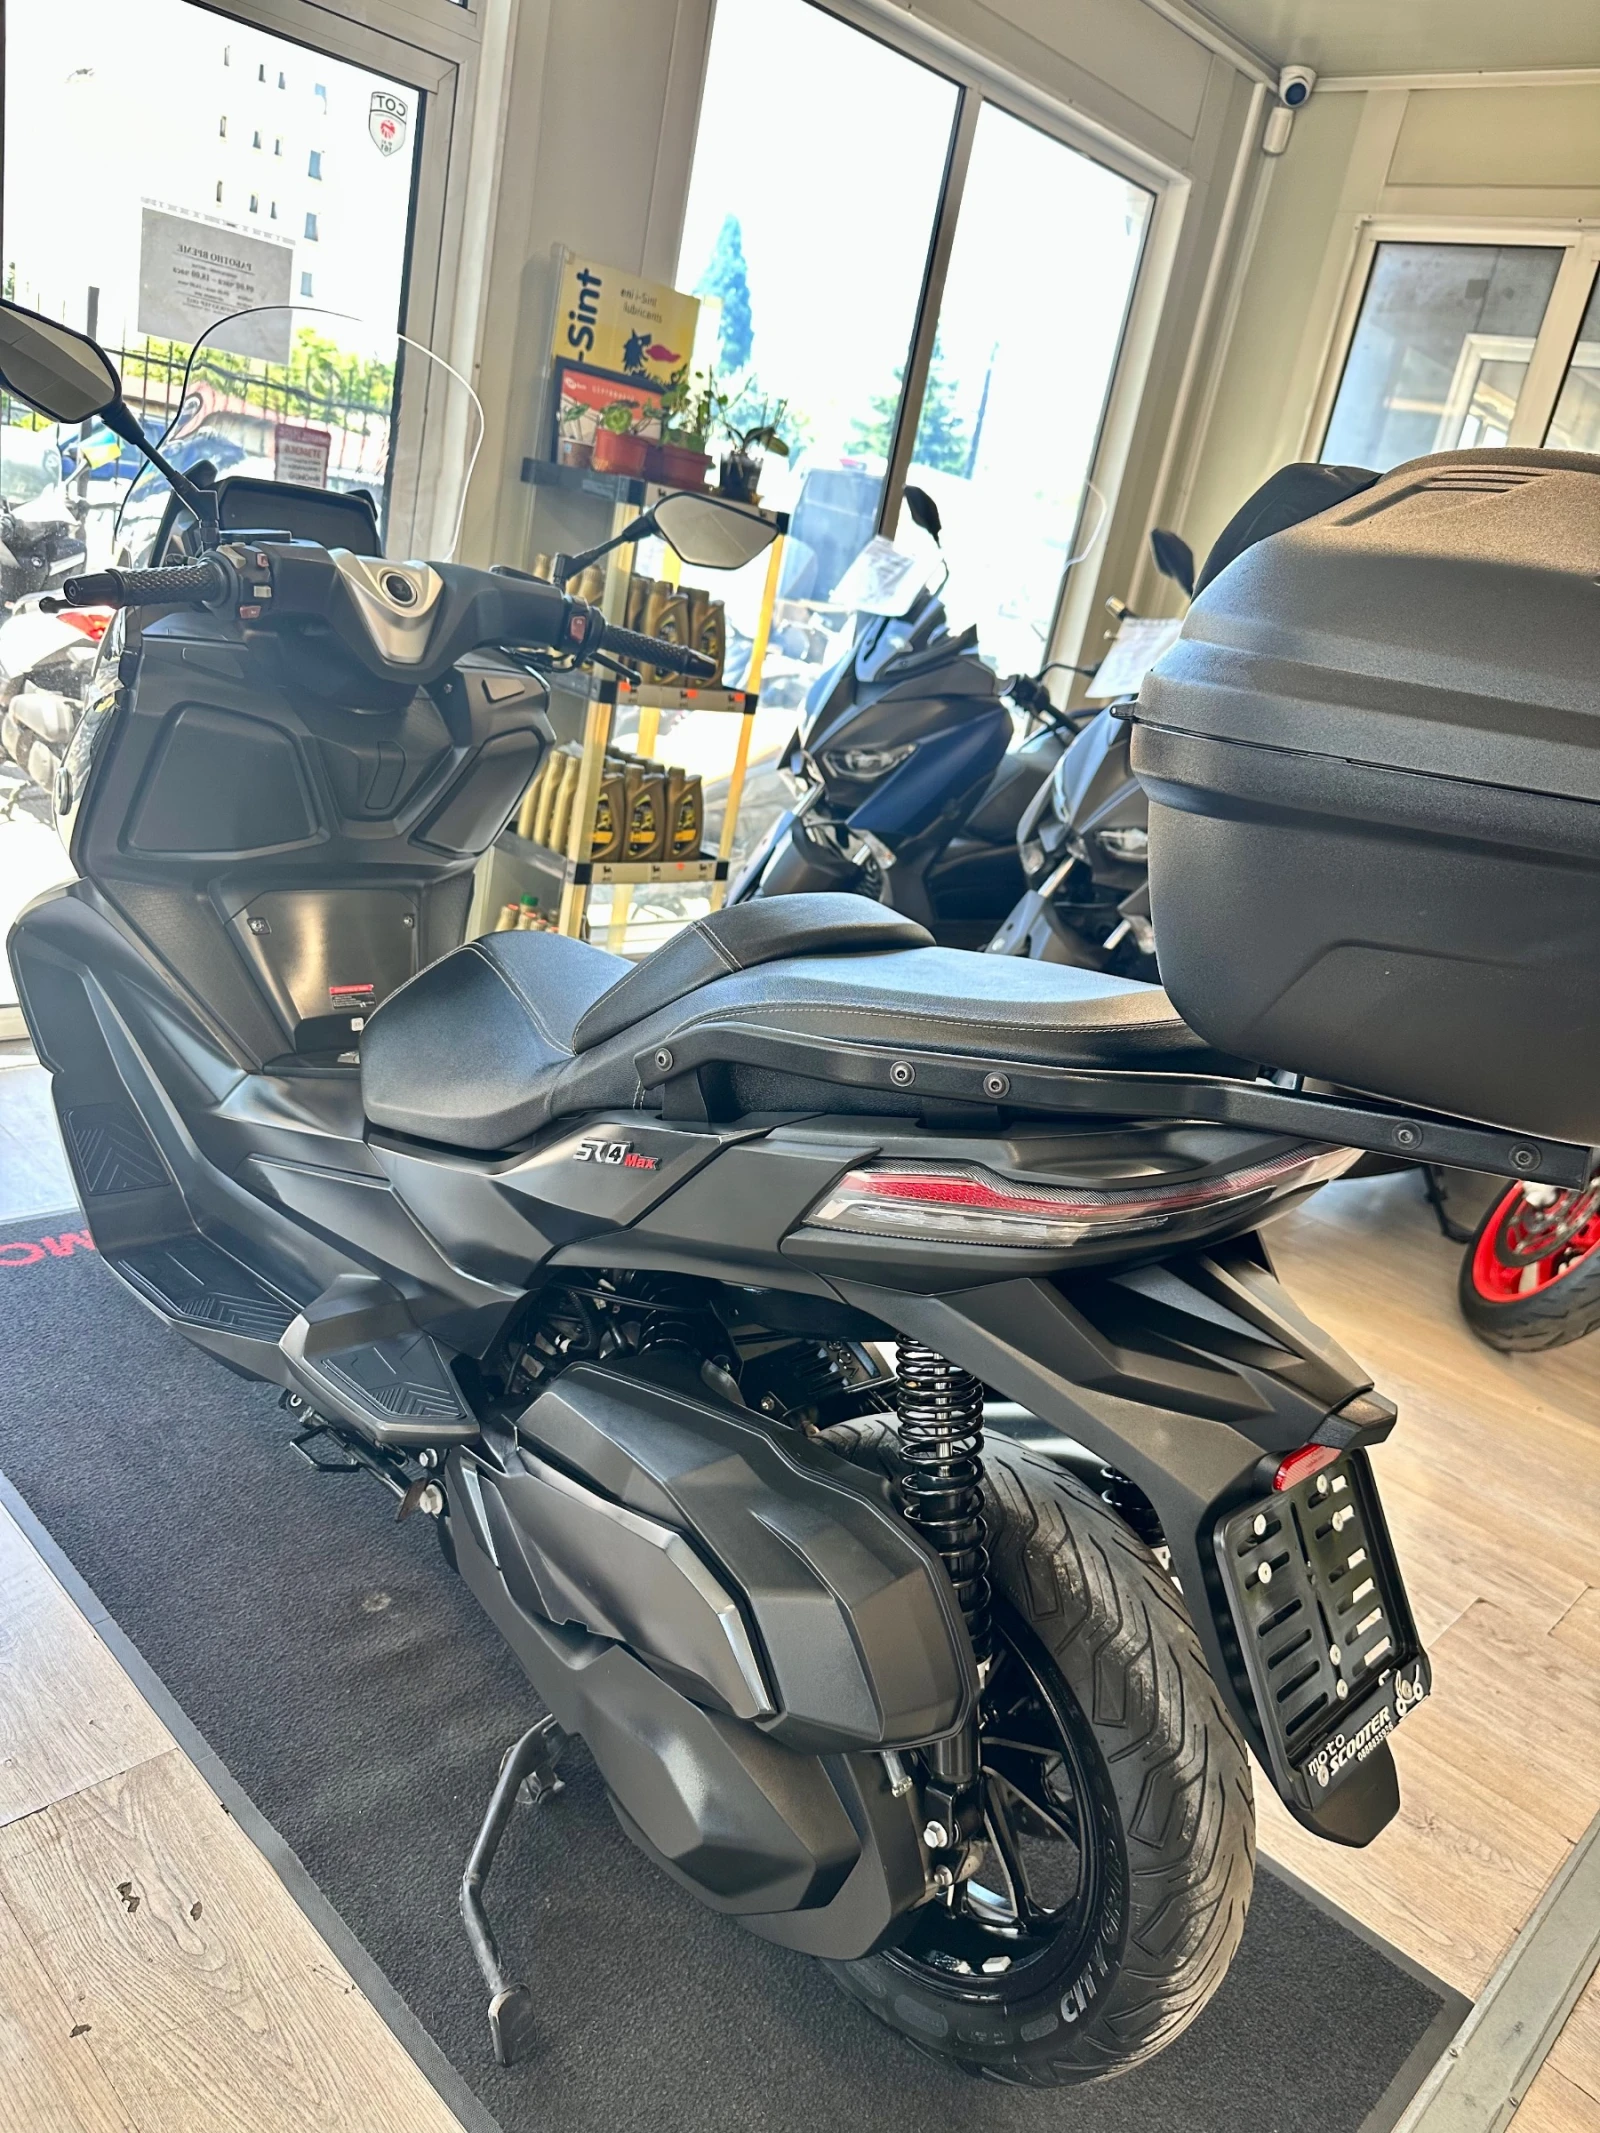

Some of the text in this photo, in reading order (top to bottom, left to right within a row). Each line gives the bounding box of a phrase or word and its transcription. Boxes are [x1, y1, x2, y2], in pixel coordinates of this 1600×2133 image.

[620, 288, 657, 306] eni i-Sint
[623, 302, 663, 324] lubricants
[624, 1153, 656, 1170] Max
[1307, 1733, 1346, 1777] moto
[1329, 1705, 1392, 1776] SCOOTER
[1061, 1936, 1109, 2023] CITY
